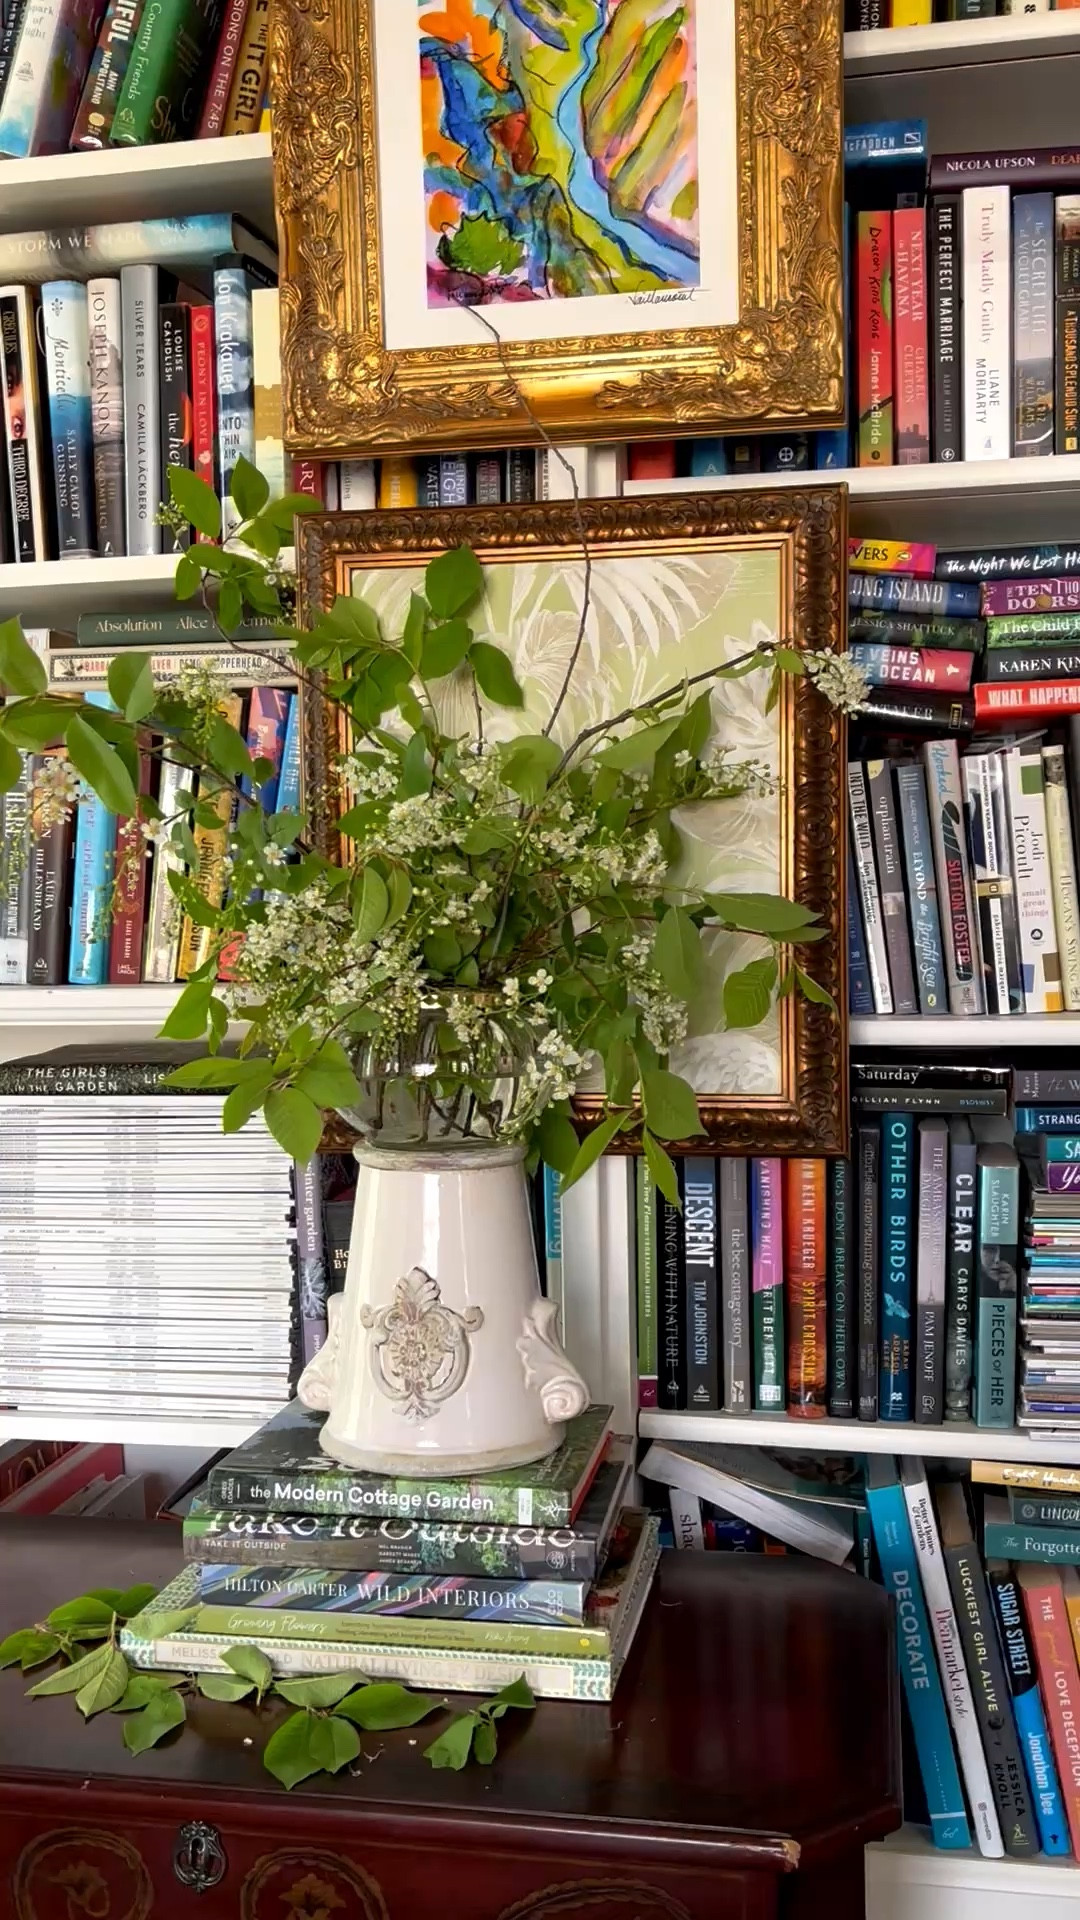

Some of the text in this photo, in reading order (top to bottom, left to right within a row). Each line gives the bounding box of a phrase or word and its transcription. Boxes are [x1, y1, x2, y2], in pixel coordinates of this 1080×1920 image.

[128, 3, 162, 100] Country Friends
[258, 23, 268, 43] THE
[91, 50, 113, 105] NAPOLITANO
[106, 70, 119, 91] ANN
[207, 45, 235, 129] ON THE 7:45
[234, 42, 267, 120] IT GIRL
[946, 157, 1036, 172] NICOLA UPSON
[7, 232, 92, 253] STORM WE
[897, 251, 908, 318] HAVANA
[911, 231, 923, 321] NEXT YEAR
[939, 207, 953, 362] THE PERFECT MARRIAGE
[981, 203, 996, 343] Truly Madly Guilty
[135, 300, 145, 378] SILVER TEARS
[163, 320, 173, 382] CANDLISH
[174, 329, 183, 372] LOUISE
[217, 274, 236, 396] Jon Krakauer
[91, 291, 112, 435] JOSEPH KANON
[988, 369, 1001, 406] LIANE
[870, 348, 882, 445] James McBride
[975, 358, 987, 424] MORIARTY
[136, 403, 147, 456] CAMILLA
[168, 413, 179, 439] the
[198, 412, 207, 446] LOVE
[12, 444, 27, 487] THIRD
[56, 443, 69, 508] GUNNING
[66, 429, 81, 520] SALLY CABOT
[946, 554, 1063, 575] The Night We Lost
[888, 581, 944, 604] ISLAND
[1016, 584, 1053, 597] TEN
[95, 616, 208, 633] Absolution Alice
[851, 619, 955, 636] JESSICA SHATTUCK
[1001, 619, 1071, 635] The Child
[870, 649, 919, 664] VEINS
[880, 665, 935, 683] OCEAN
[999, 658, 1051, 673] KAREN
[988, 688, 1023, 706] WHAT
[849, 772, 870, 848] INTO THE WILD
[875, 796, 899, 874] orphan train
[988, 841, 996, 872] SOLITUDE
[1013, 815, 1033, 880] Picoult
[1031, 831, 1045, 861] Jodi
[33, 849, 45, 931] HILLENBRAND
[45, 870, 56, 909] LAURA
[947, 858, 971, 964] SUTTON FOSTER
[1021, 888, 1047, 897] small
[1021, 909, 1049, 919] things
[1023, 899, 1046, 911] great
[912, 851, 937, 988] BEYOND Bright Sea
[1066, 940, 1079, 982] SWING
[14, 1081, 118, 1093] IN THE GARDEN
[27, 1067, 108, 1078] THE GIRLS
[857, 1068, 920, 1085] Saturday
[904, 1097, 941, 1106] FLYNN
[932, 1146, 944, 1171] THE
[889, 1122, 908, 1283] OTHER BIRDS
[991, 1179, 1001, 1238] SLAUGHTER
[1000, 1193, 1010, 1225] KARIN
[303, 1206, 316, 1252] garden
[760, 1234, 773, 1265] HALF
[684, 1182, 715, 1365] DESCENT TIM JOHNSTON
[728, 1228, 745, 1348] the bee story
[955, 1173, 974, 1366] CLEAR CARYS DAVIES
[801, 1218, 817, 1383] KRUEGER SPIRIT CROSSING
[834, 1201, 846, 1389] DON'T BREAK ON THEIR OWN
[665, 1303, 680, 1368] NATURE
[923, 1311, 937, 1382] PAM JENOFF
[991, 1304, 1005, 1356] PIECES
[991, 1376, 1005, 1407] HER
[250, 1482, 494, 1512] the Modern Cottage Garden
[204, 1539, 287, 1550] TAKE OUTSIDE
[918, 1497, 936, 1556] Better Homes
[225, 1576, 281, 1592] HILTON
[287, 1580, 348, 1597] CARTER
[356, 1583, 411, 1602] WILD
[418, 1587, 531, 1610] INTERIORS
[891, 1569, 931, 1690] DECORATE
[958, 1558, 999, 1712] LUCKIEST GIRL ALIVE
[996, 1582, 1056, 1816] SUGAR STREET Jonathan Dee
[1039, 1595, 1080, 1788] THE LOVE DECEPTION
[993, 1762, 1011, 1809] KNOLL
[1005, 1756, 1025, 1817] JESSICA
